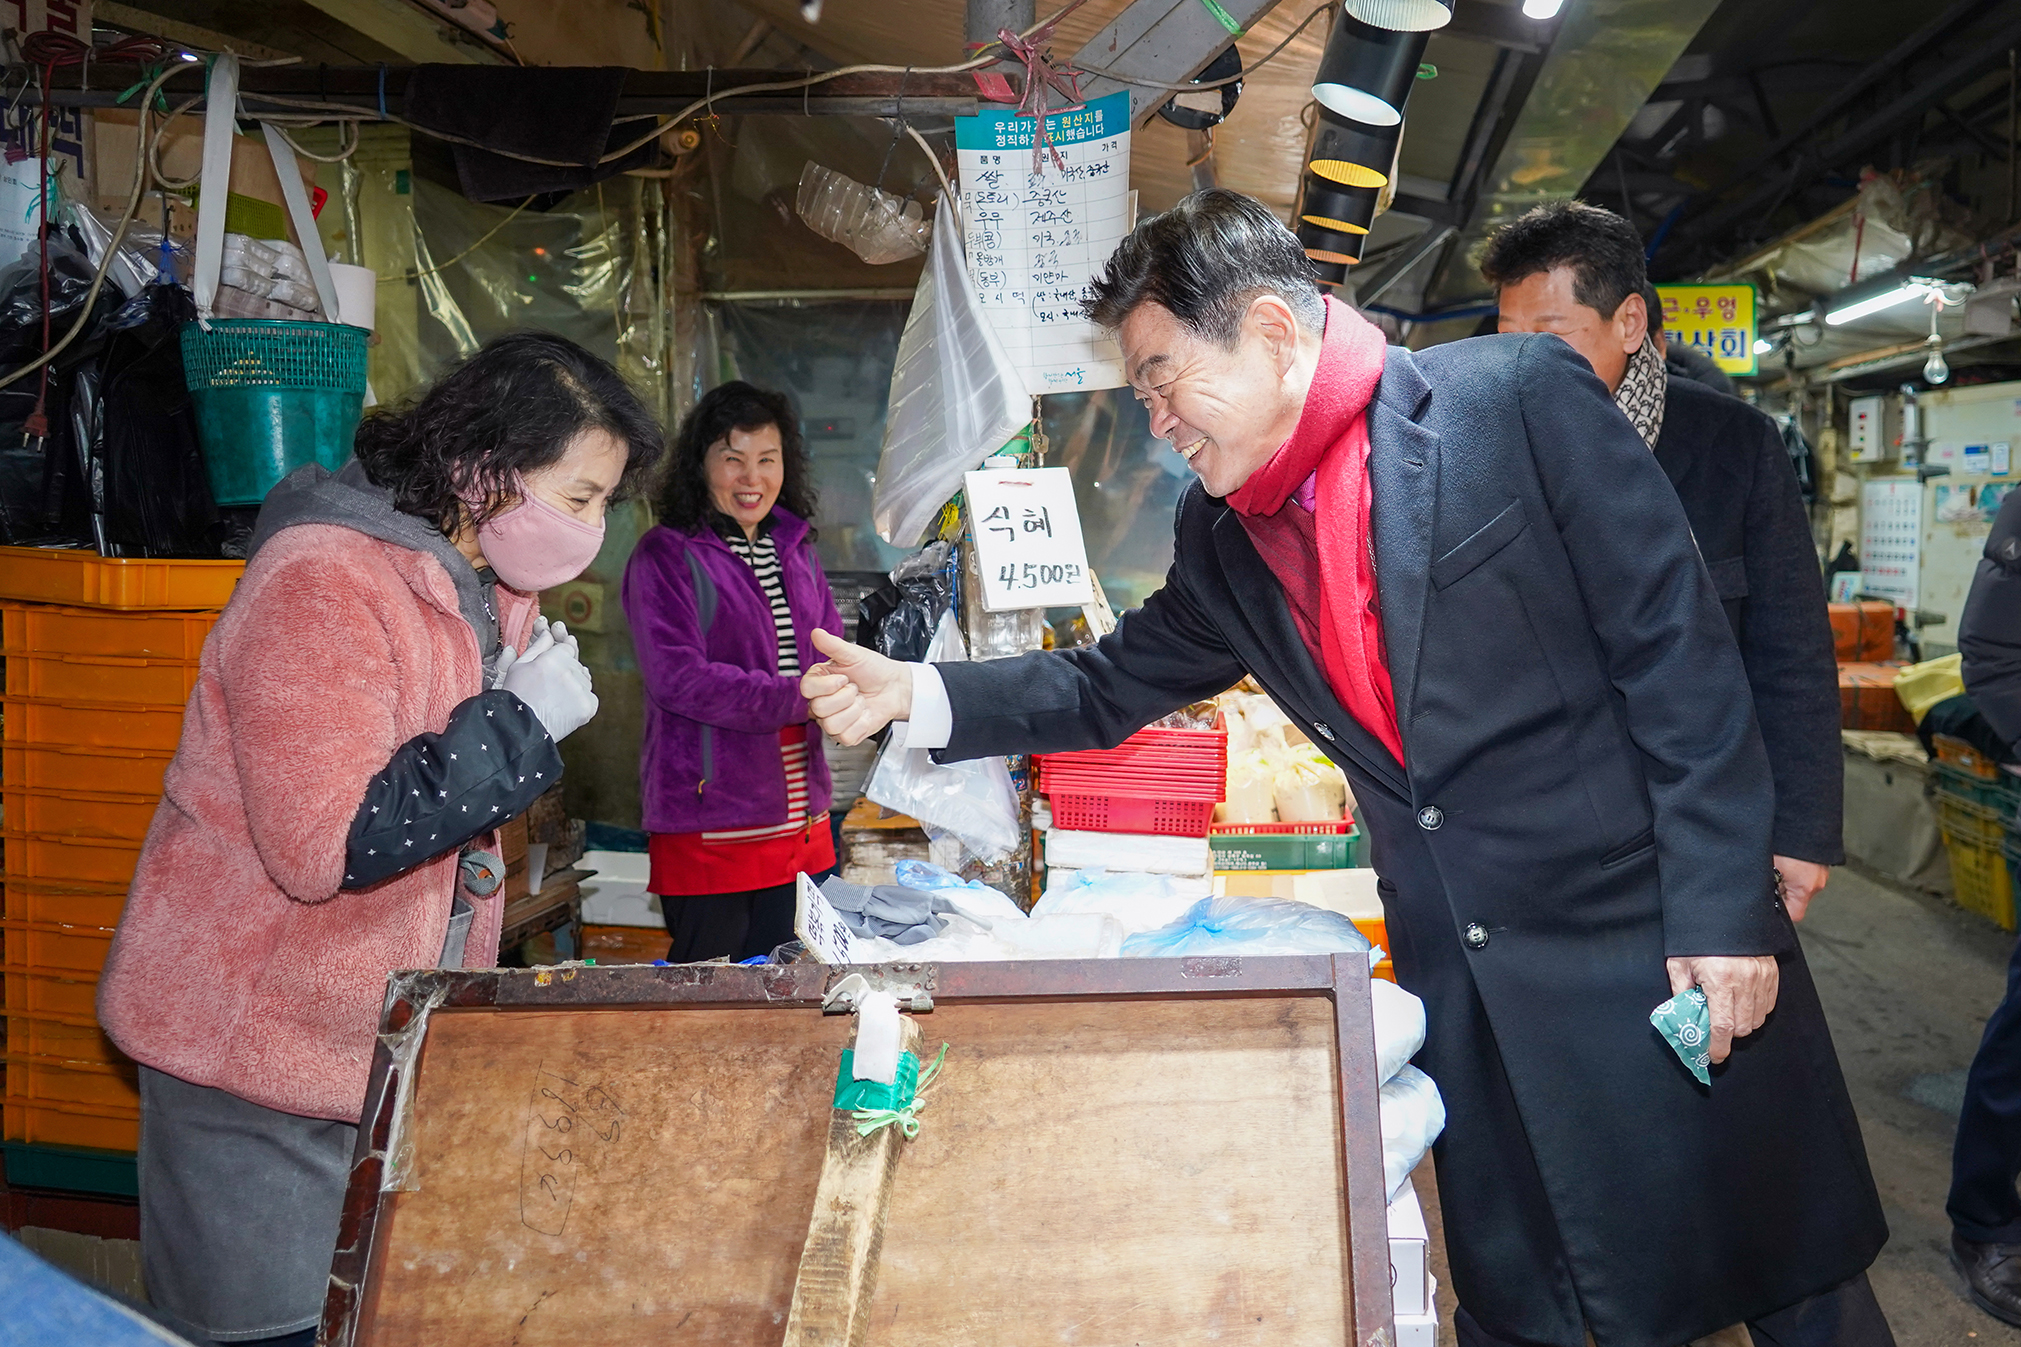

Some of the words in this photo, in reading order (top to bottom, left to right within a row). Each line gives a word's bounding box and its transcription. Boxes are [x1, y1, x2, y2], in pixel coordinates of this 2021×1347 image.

[994, 118, 1056, 134] 우리가는
[1061, 109, 1104, 129] 원산지를
[995, 133, 1037, 148] 정직하
[1040, 151, 1069, 164] 원지
[1101, 140, 1118, 152] 가격
[1021, 188, 1067, 207] 중국산
[1029, 208, 1074, 226] 제주산
[1032, 270, 1069, 285] 미얀마
[980, 505, 1054, 543] 식혜
